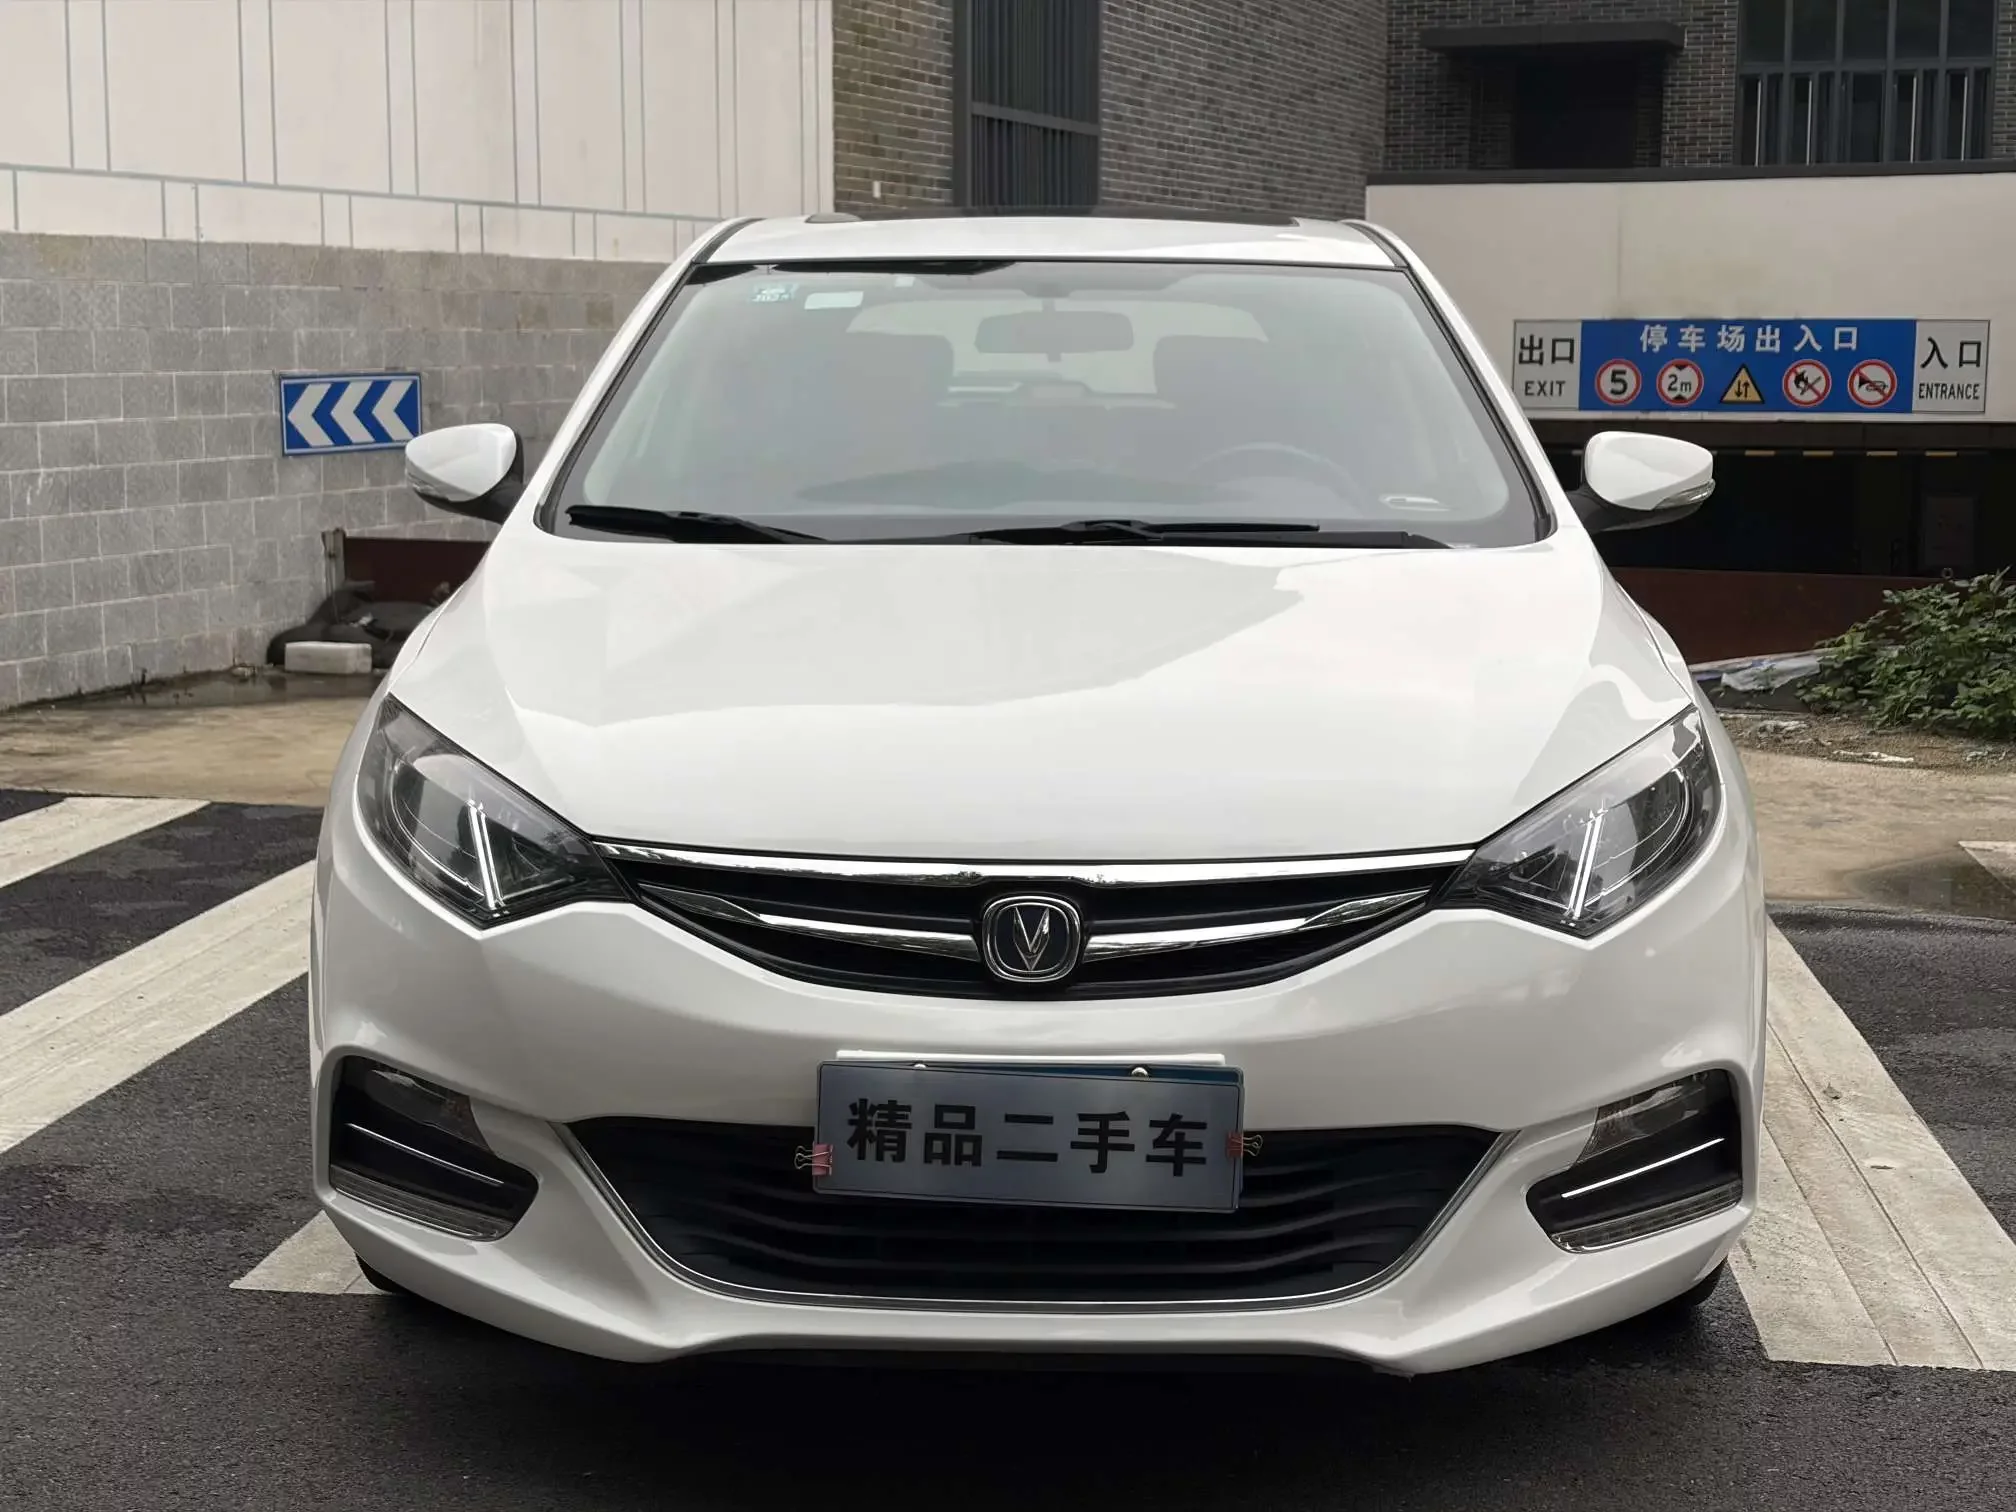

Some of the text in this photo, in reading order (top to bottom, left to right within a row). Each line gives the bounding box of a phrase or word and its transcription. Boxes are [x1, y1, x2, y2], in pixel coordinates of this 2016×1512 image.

[1519, 334, 1574, 366] 出口
[1640, 324, 1858, 352] 停车场出入口
[1921, 336, 1981, 369] 入口
[1525, 381, 1566, 396] EXIT
[1610, 369, 1628, 395] 5
[1668, 374, 1692, 392] 2m
[1919, 382, 1980, 400] ENTRANCE
[846, 1097, 1208, 1177] 精品二手车
